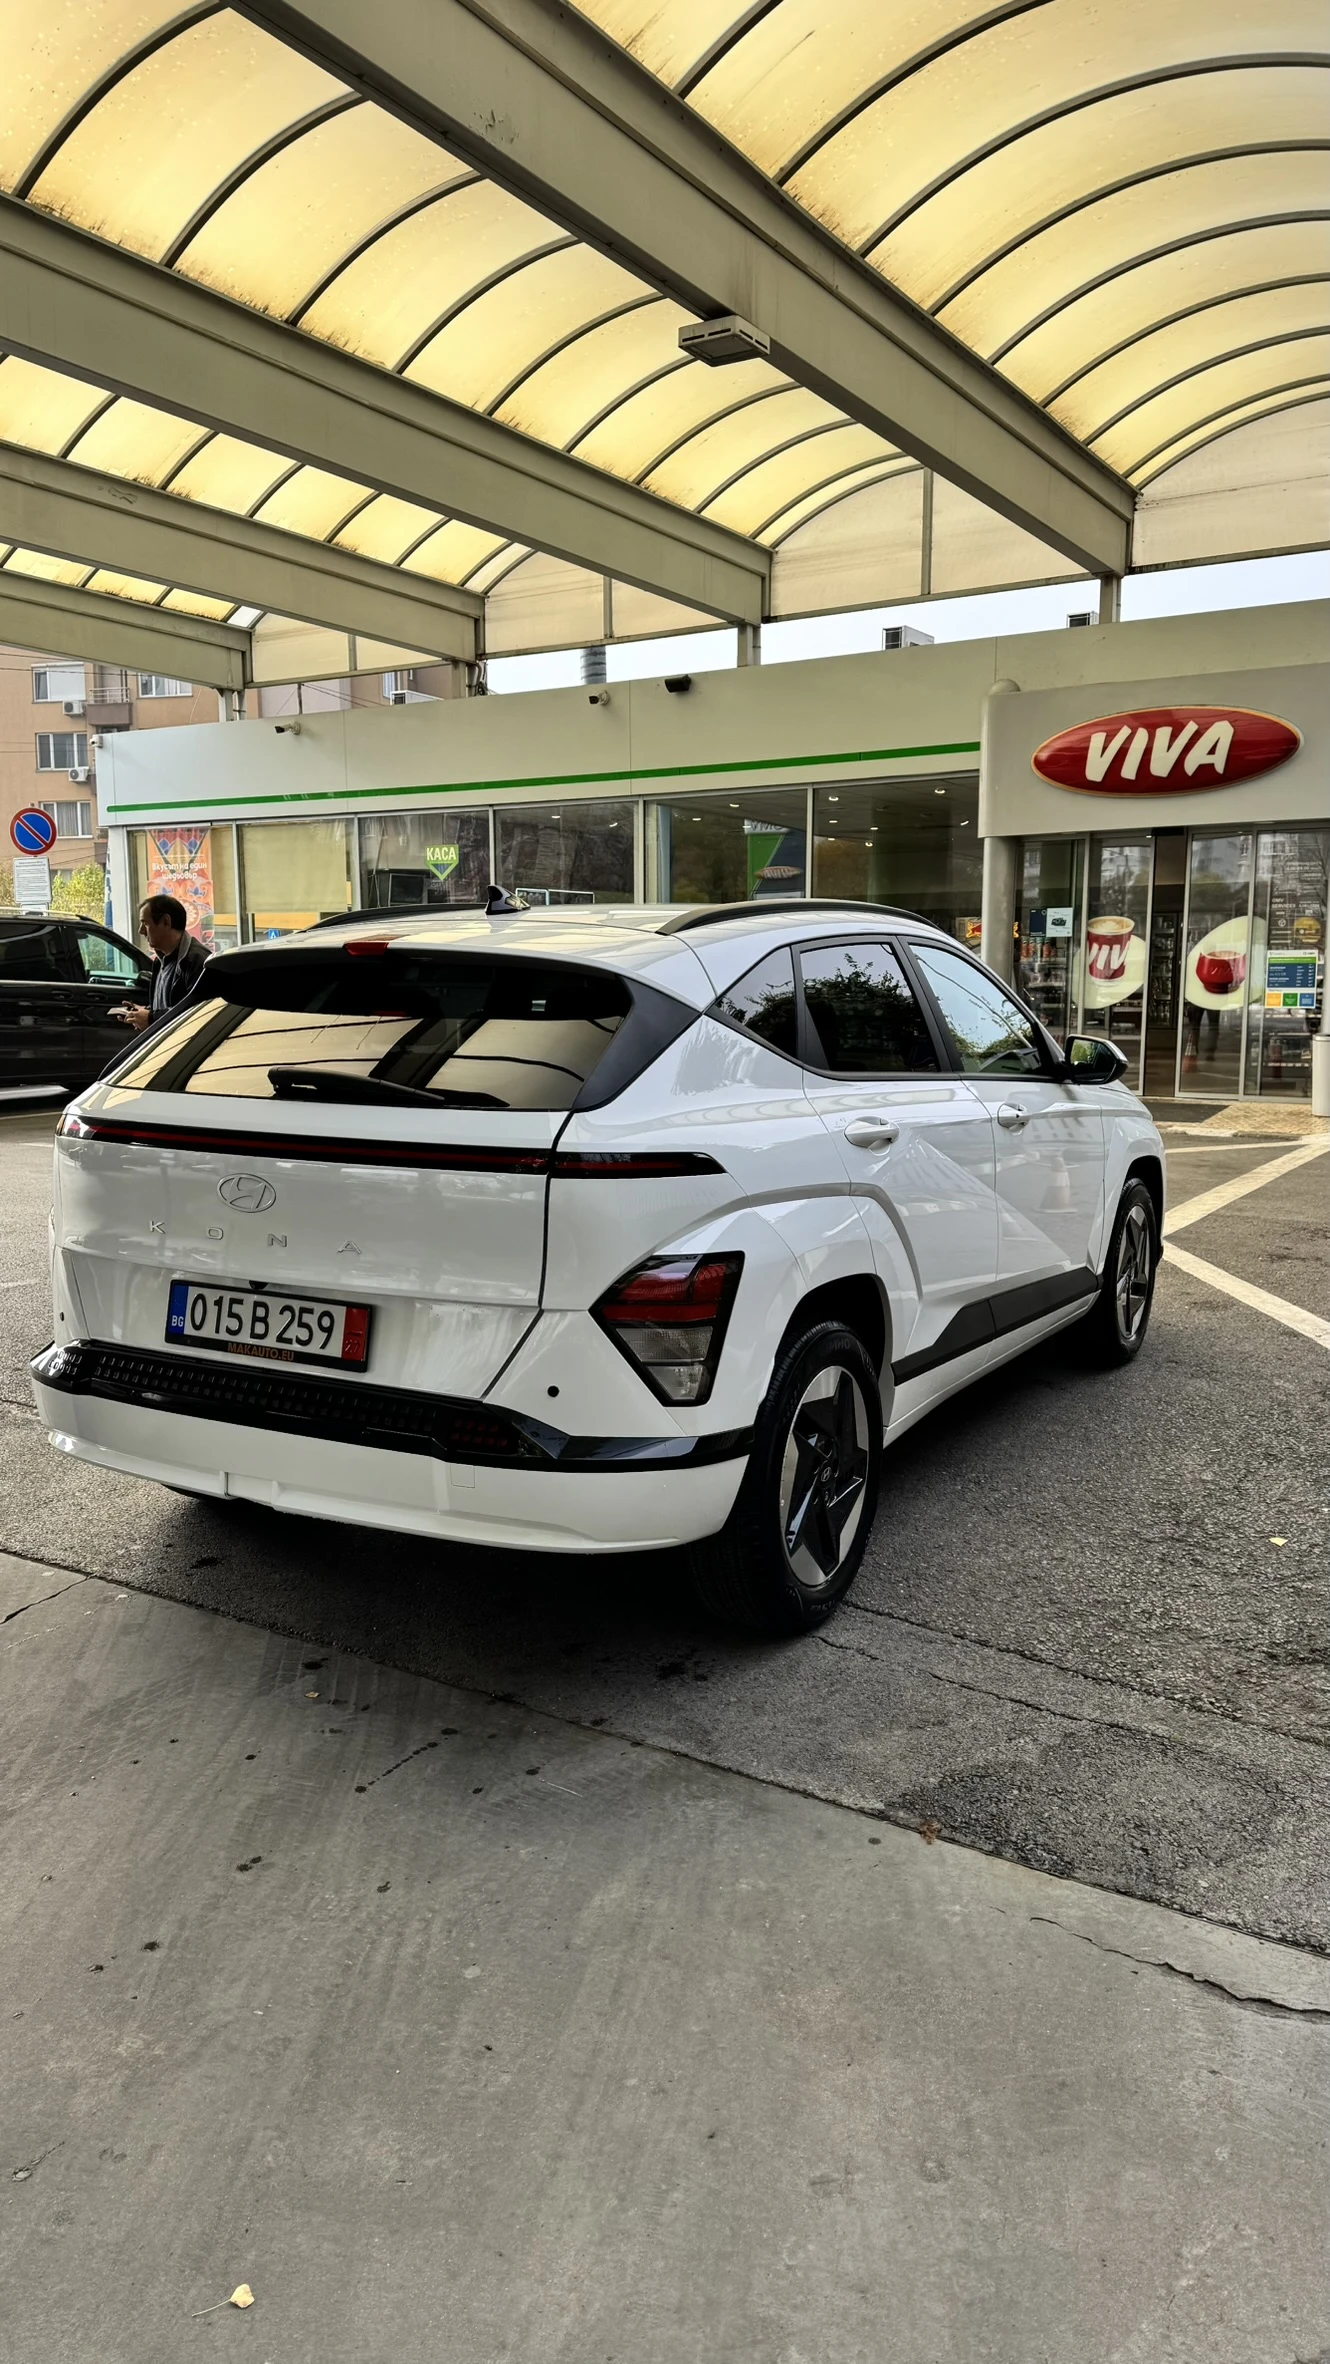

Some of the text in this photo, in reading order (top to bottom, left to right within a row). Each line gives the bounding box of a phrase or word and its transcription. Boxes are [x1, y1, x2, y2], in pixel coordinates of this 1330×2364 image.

[1085, 719, 1235, 783] VIVA
[426, 846, 457, 861] КАСА
[149, 1220, 362, 1255] KONA
[171, 1315, 184, 1328] BG
[227, 1341, 294, 1362] MAKAUTO.EU
